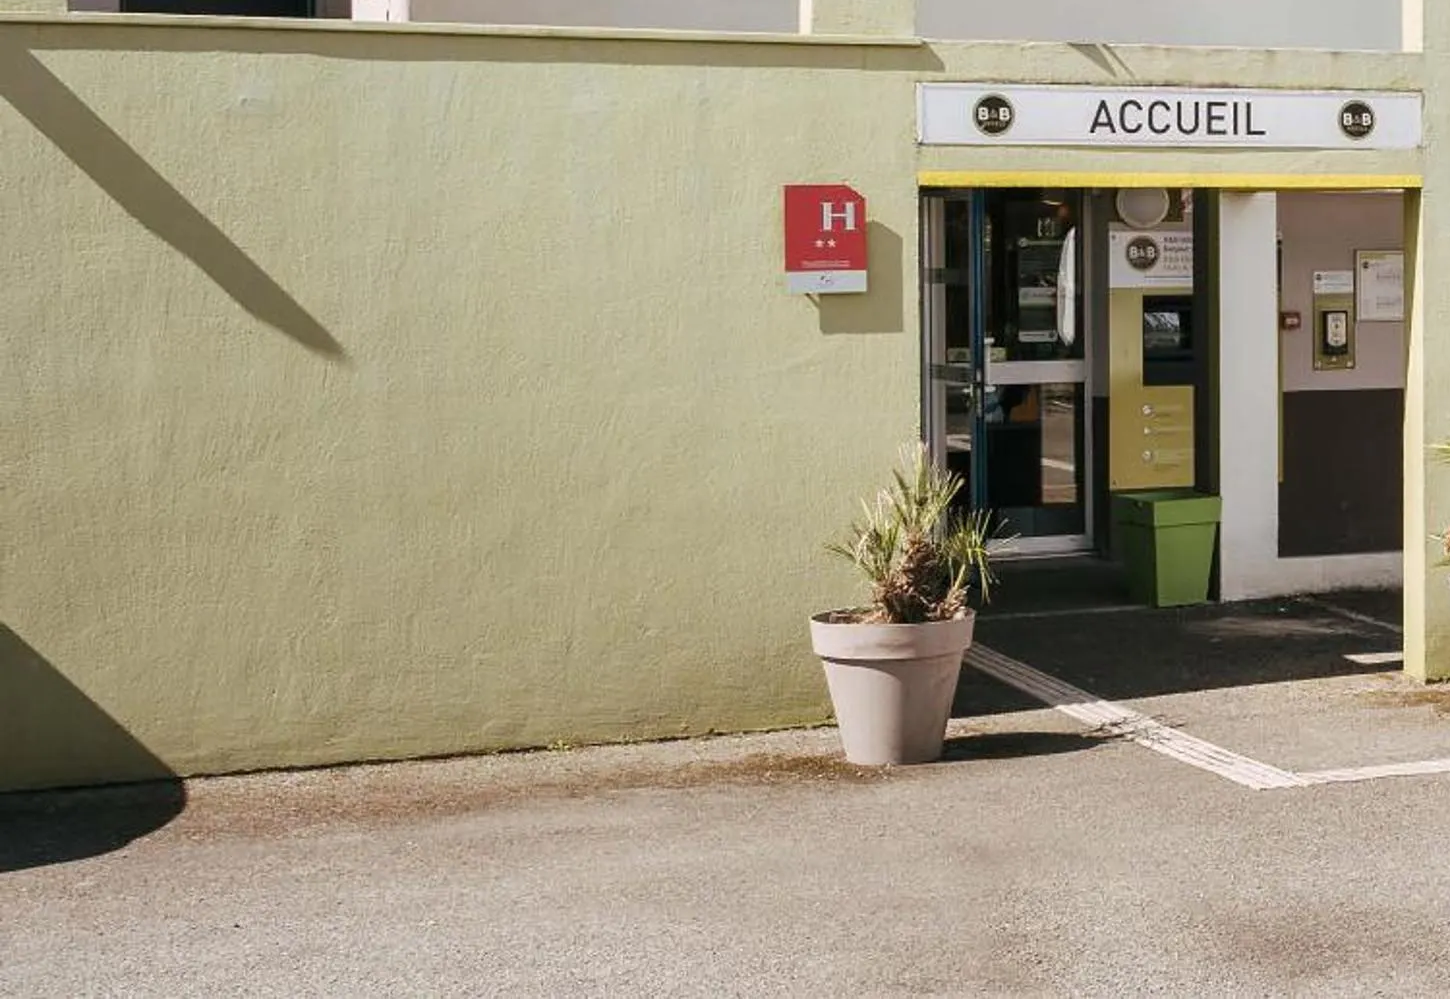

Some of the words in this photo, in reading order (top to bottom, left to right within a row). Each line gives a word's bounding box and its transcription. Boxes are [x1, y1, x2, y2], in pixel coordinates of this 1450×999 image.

[978, 106, 1010, 121] B&B
[1089, 99, 1266, 136] ACCUEIL
[1343, 112, 1371, 126] B&B
[821, 201, 856, 231] H
